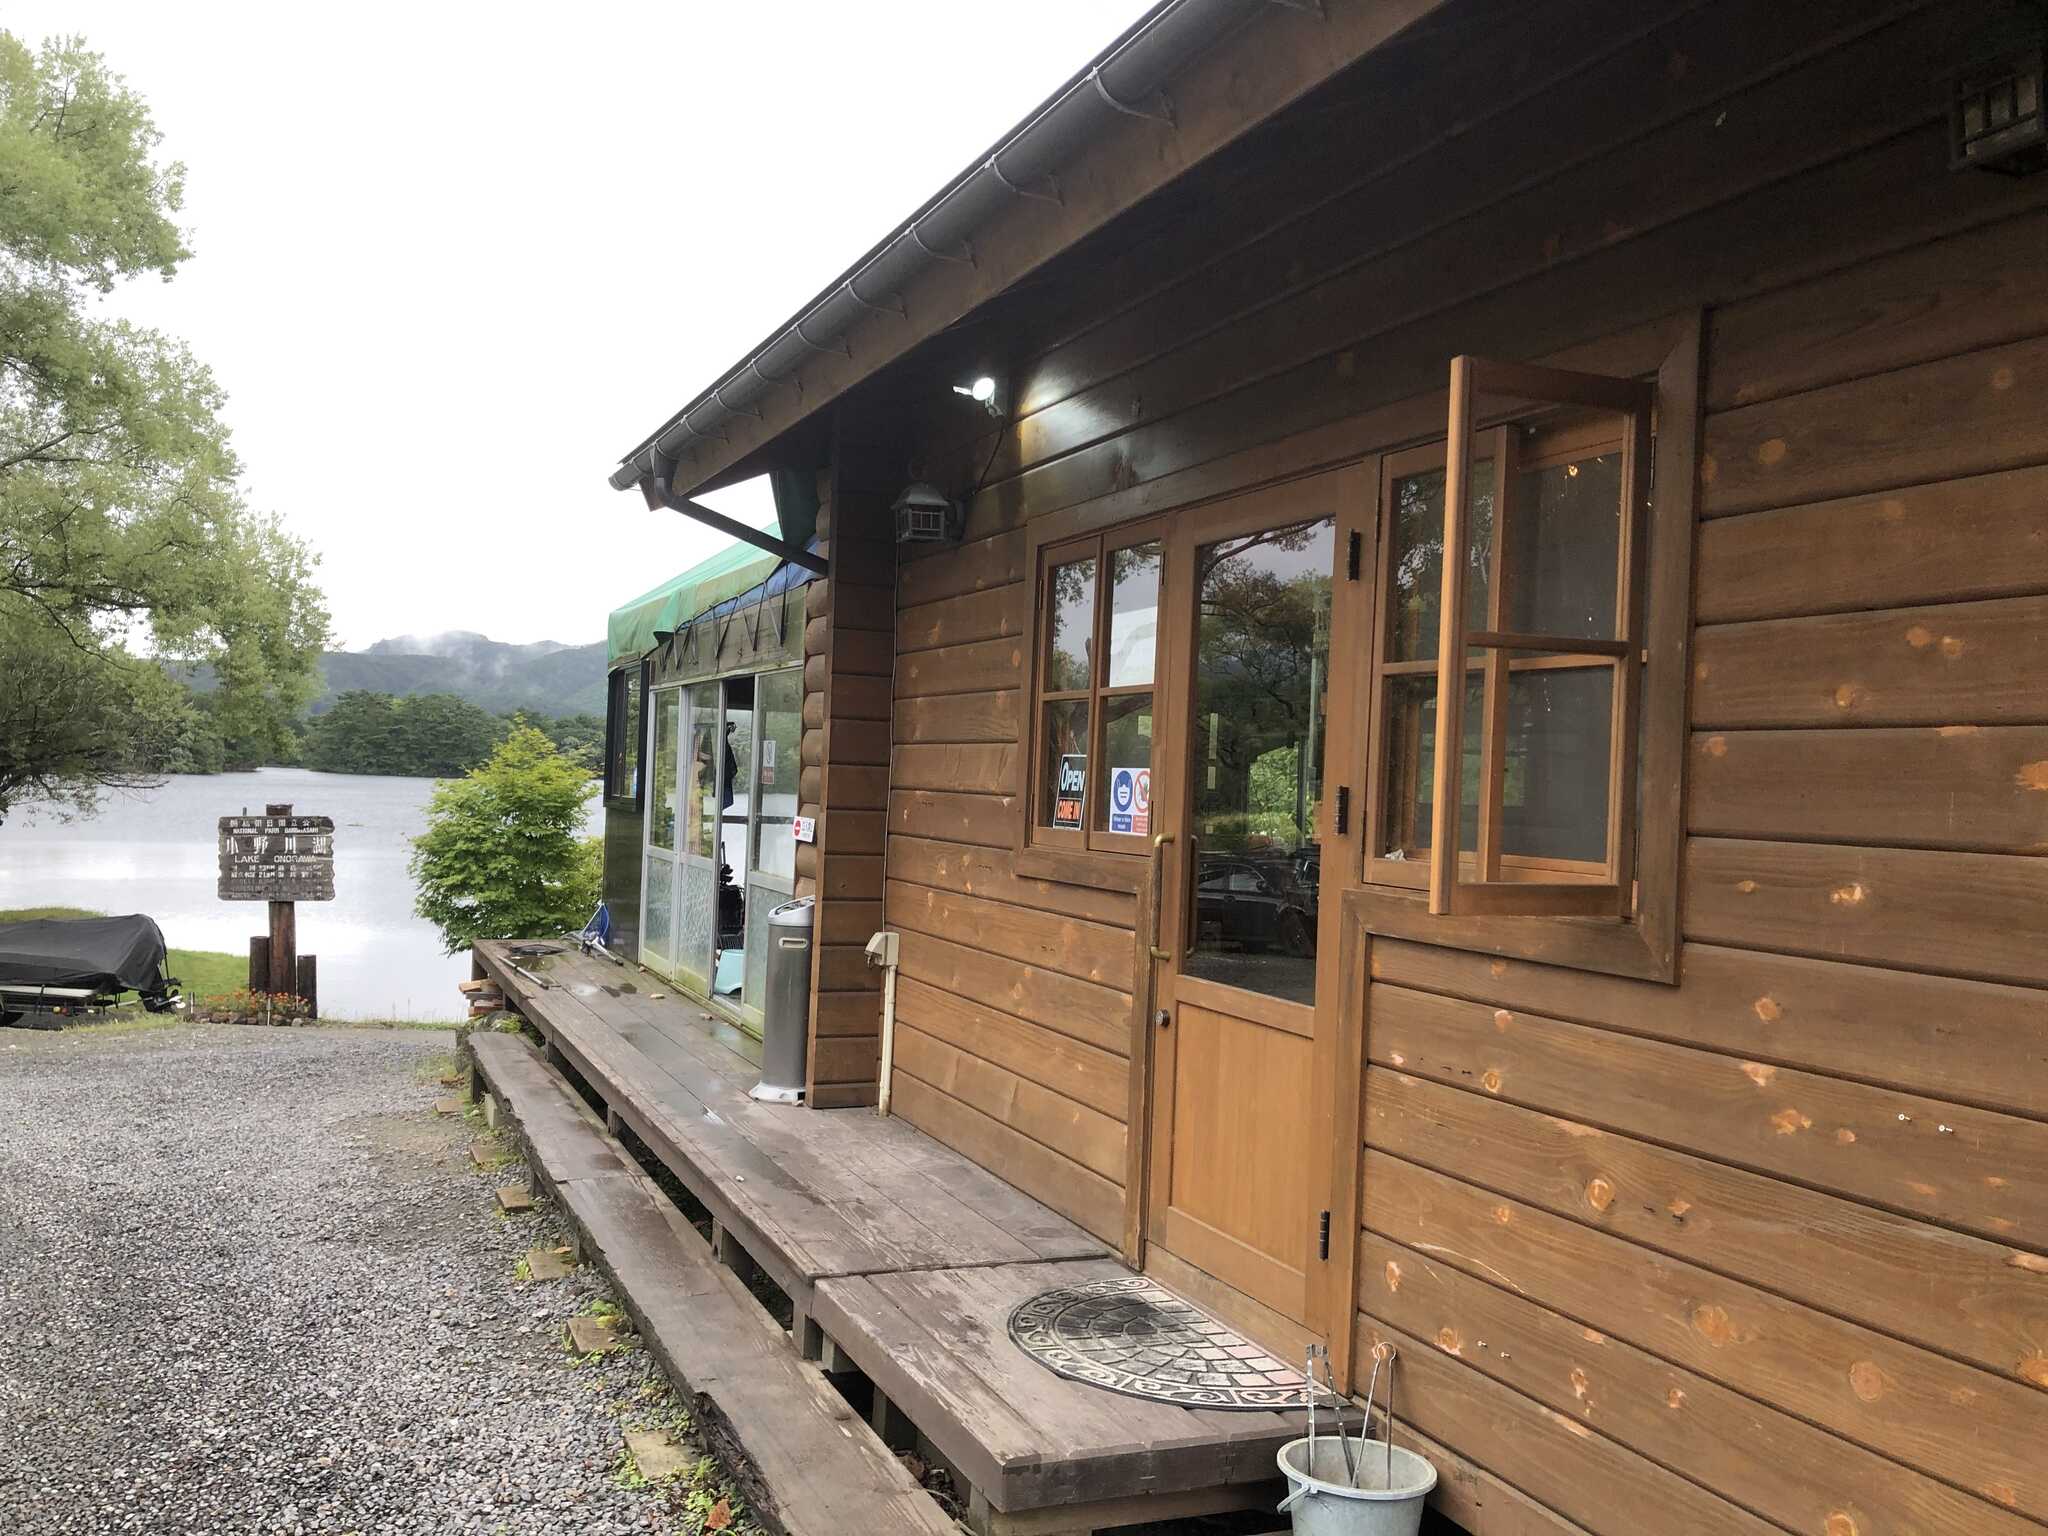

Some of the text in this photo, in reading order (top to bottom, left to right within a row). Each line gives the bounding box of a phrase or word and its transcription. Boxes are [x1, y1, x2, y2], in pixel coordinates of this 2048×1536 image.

[1061, 761, 1085, 791] OPEN
[1057, 800, 1074, 818] COME
[226, 836, 327, 854] 小野川湖
[234, 855, 260, 863] LAKE
